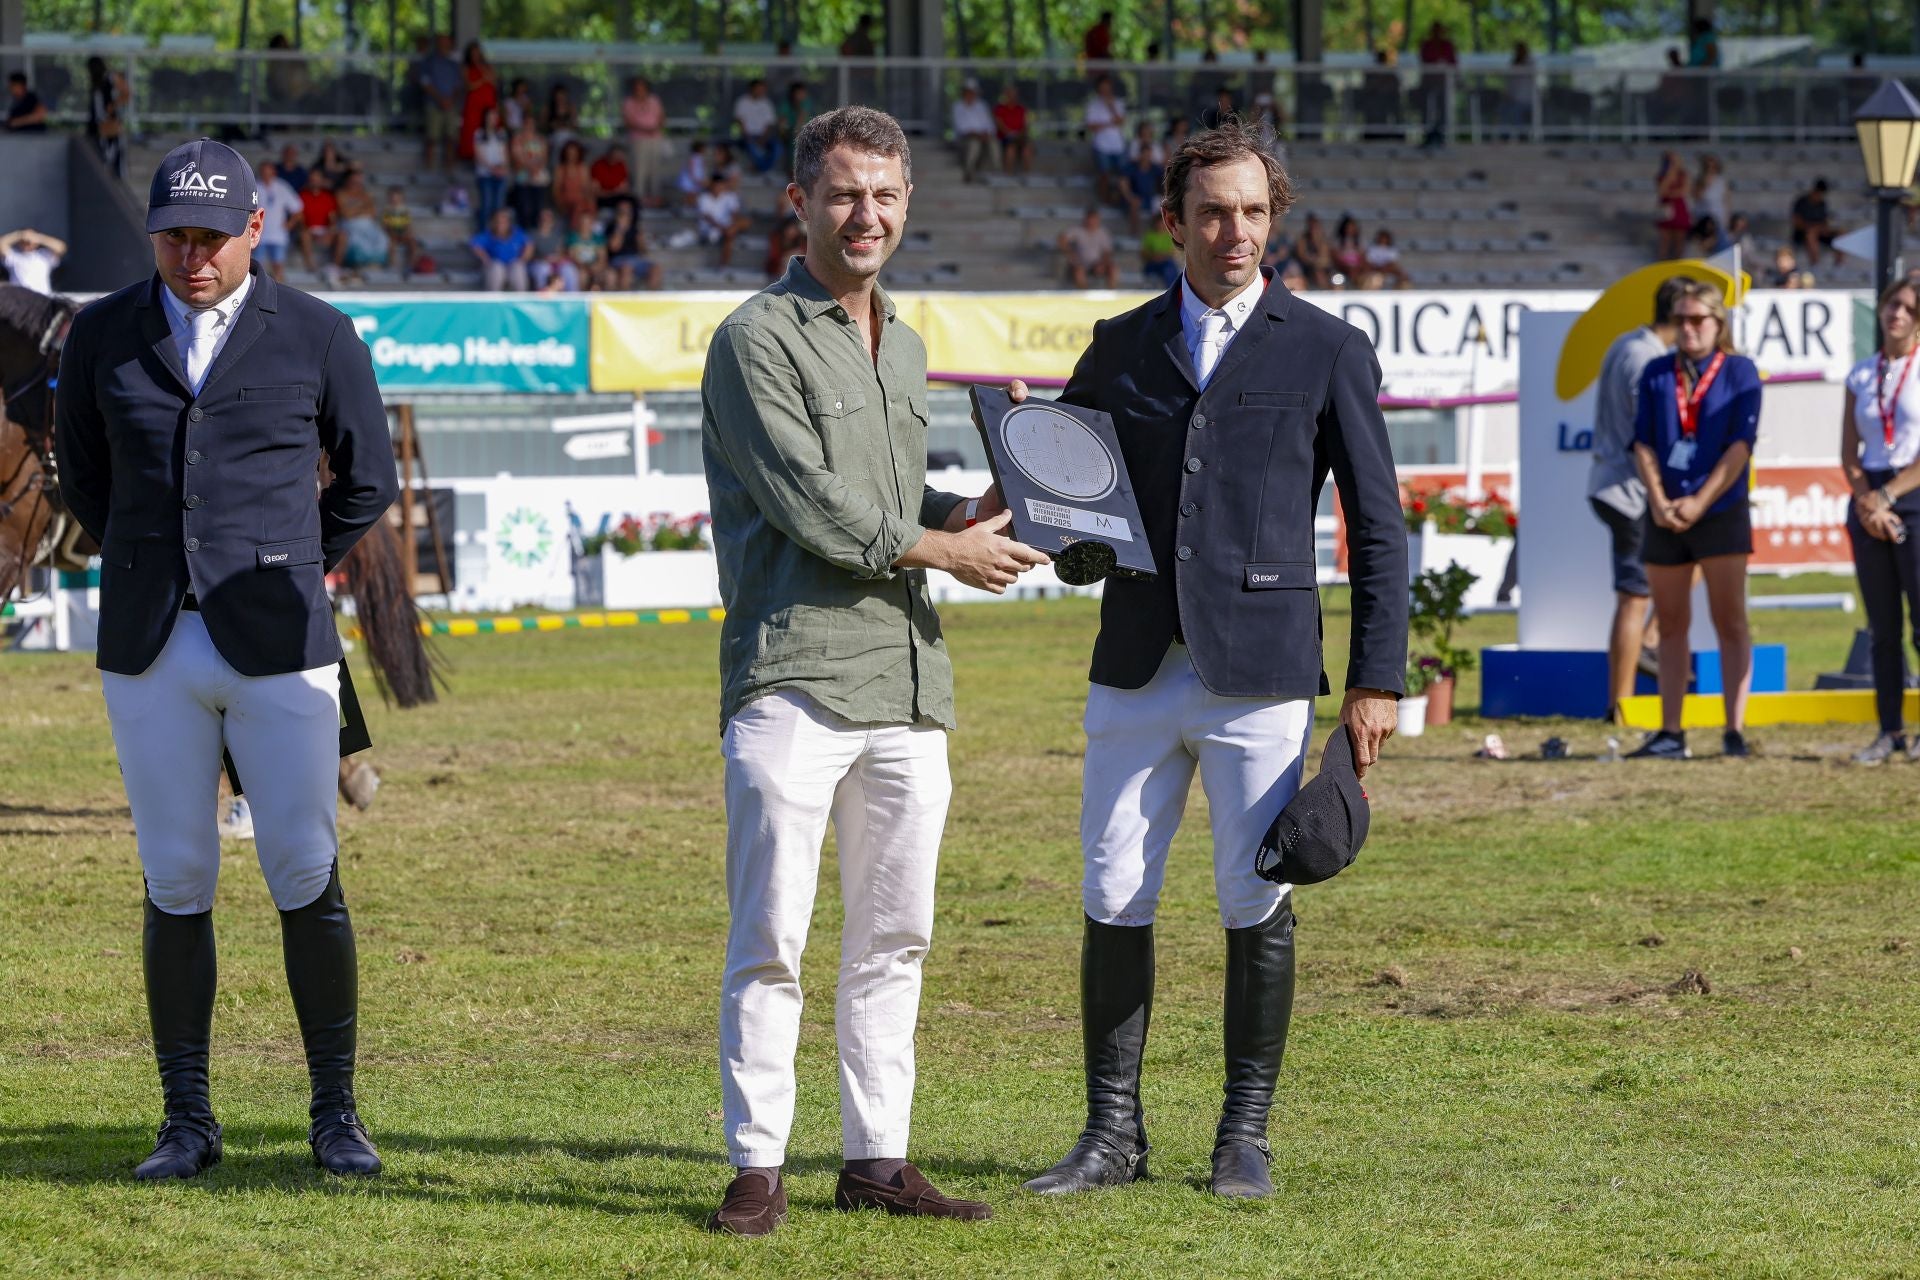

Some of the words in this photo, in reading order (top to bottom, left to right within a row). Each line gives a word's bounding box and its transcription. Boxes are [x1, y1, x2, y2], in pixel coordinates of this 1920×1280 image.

[170, 172, 227, 193] JAC
[373, 336, 461, 373] Grupo
[1053, 518, 1072, 528] 2025
[1260, 574, 1279, 582] EGO7
